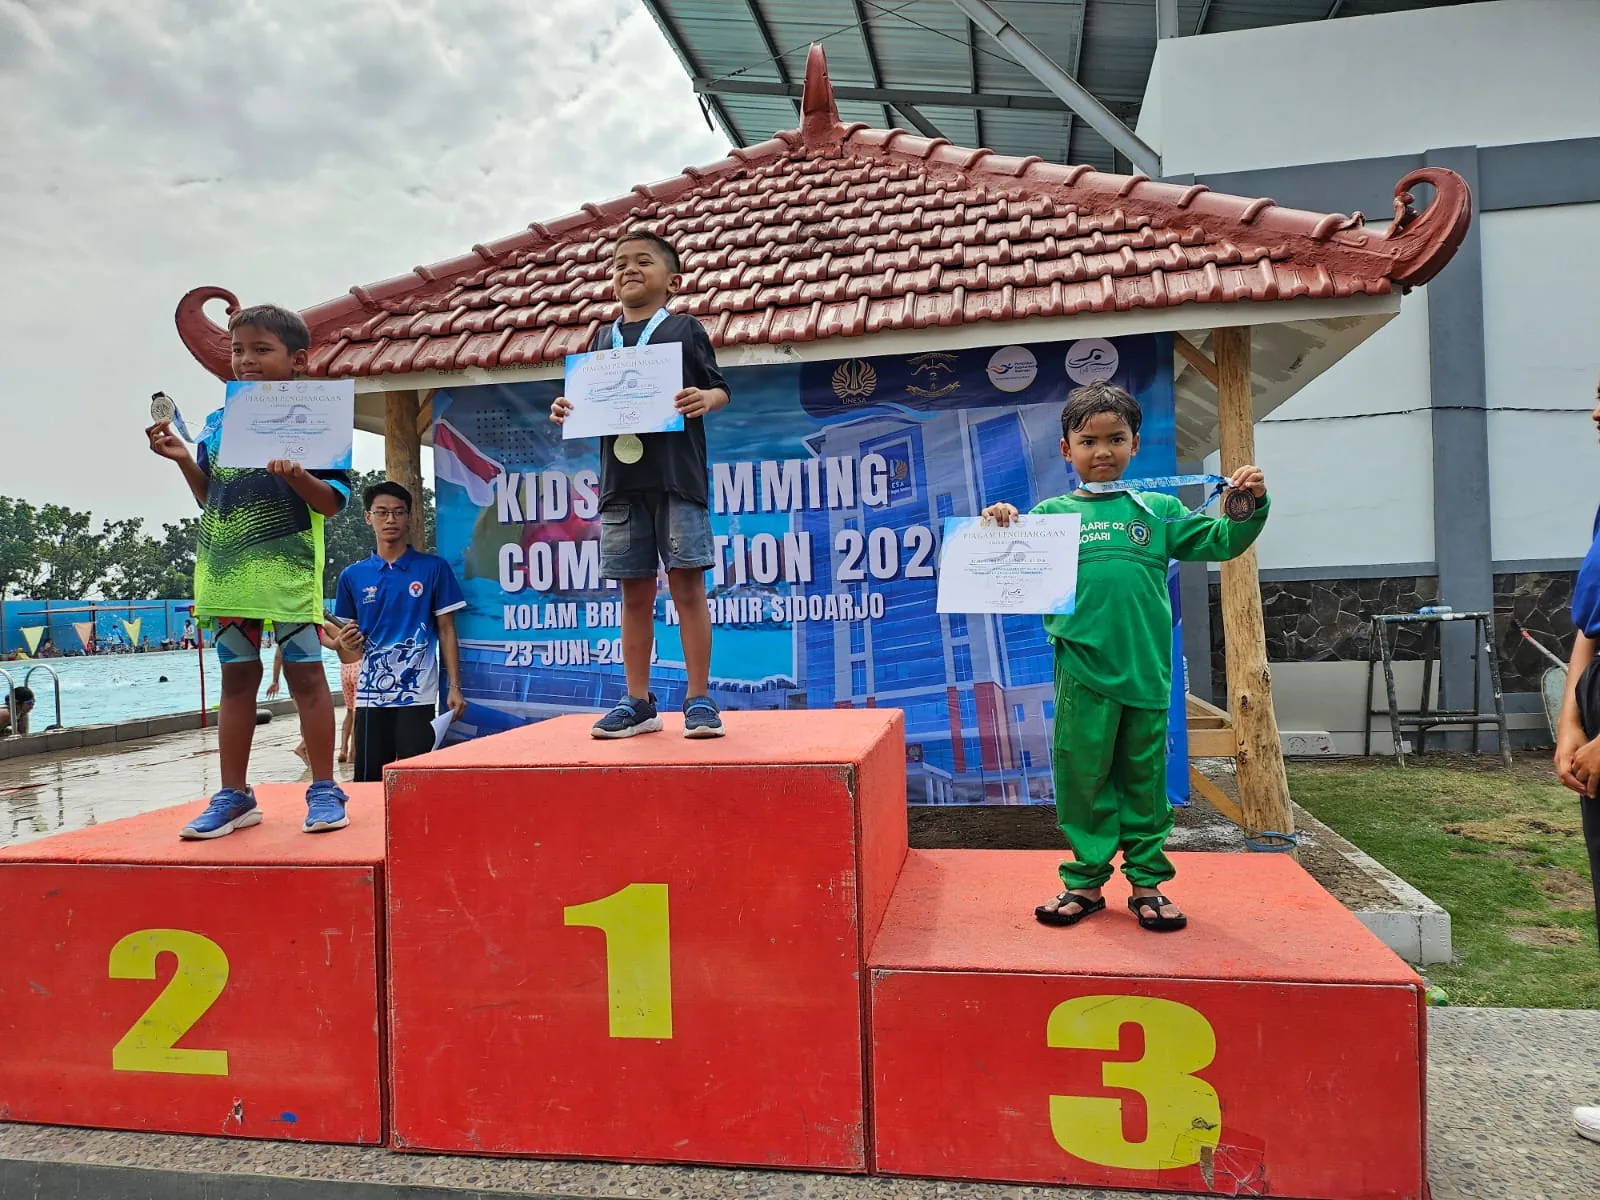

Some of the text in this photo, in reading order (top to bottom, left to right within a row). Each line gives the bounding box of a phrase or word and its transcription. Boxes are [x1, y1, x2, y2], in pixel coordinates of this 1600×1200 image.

[496, 453, 889, 522] KIDS MMING
[499, 525, 934, 593] COMTION 202
[1079, 532, 1110, 544] OSARI
[1080, 521, 1125, 532] AARIF 02
[503, 602, 578, 630] KOLAM
[665, 597, 763, 626] MRINIR
[771, 592, 885, 623] SIDOARJO
[504, 637, 658, 667] 23 JUNI 20
[563, 883, 673, 1039] 1
[108, 928, 230, 1076] 2
[1046, 994, 1222, 1169] 3
